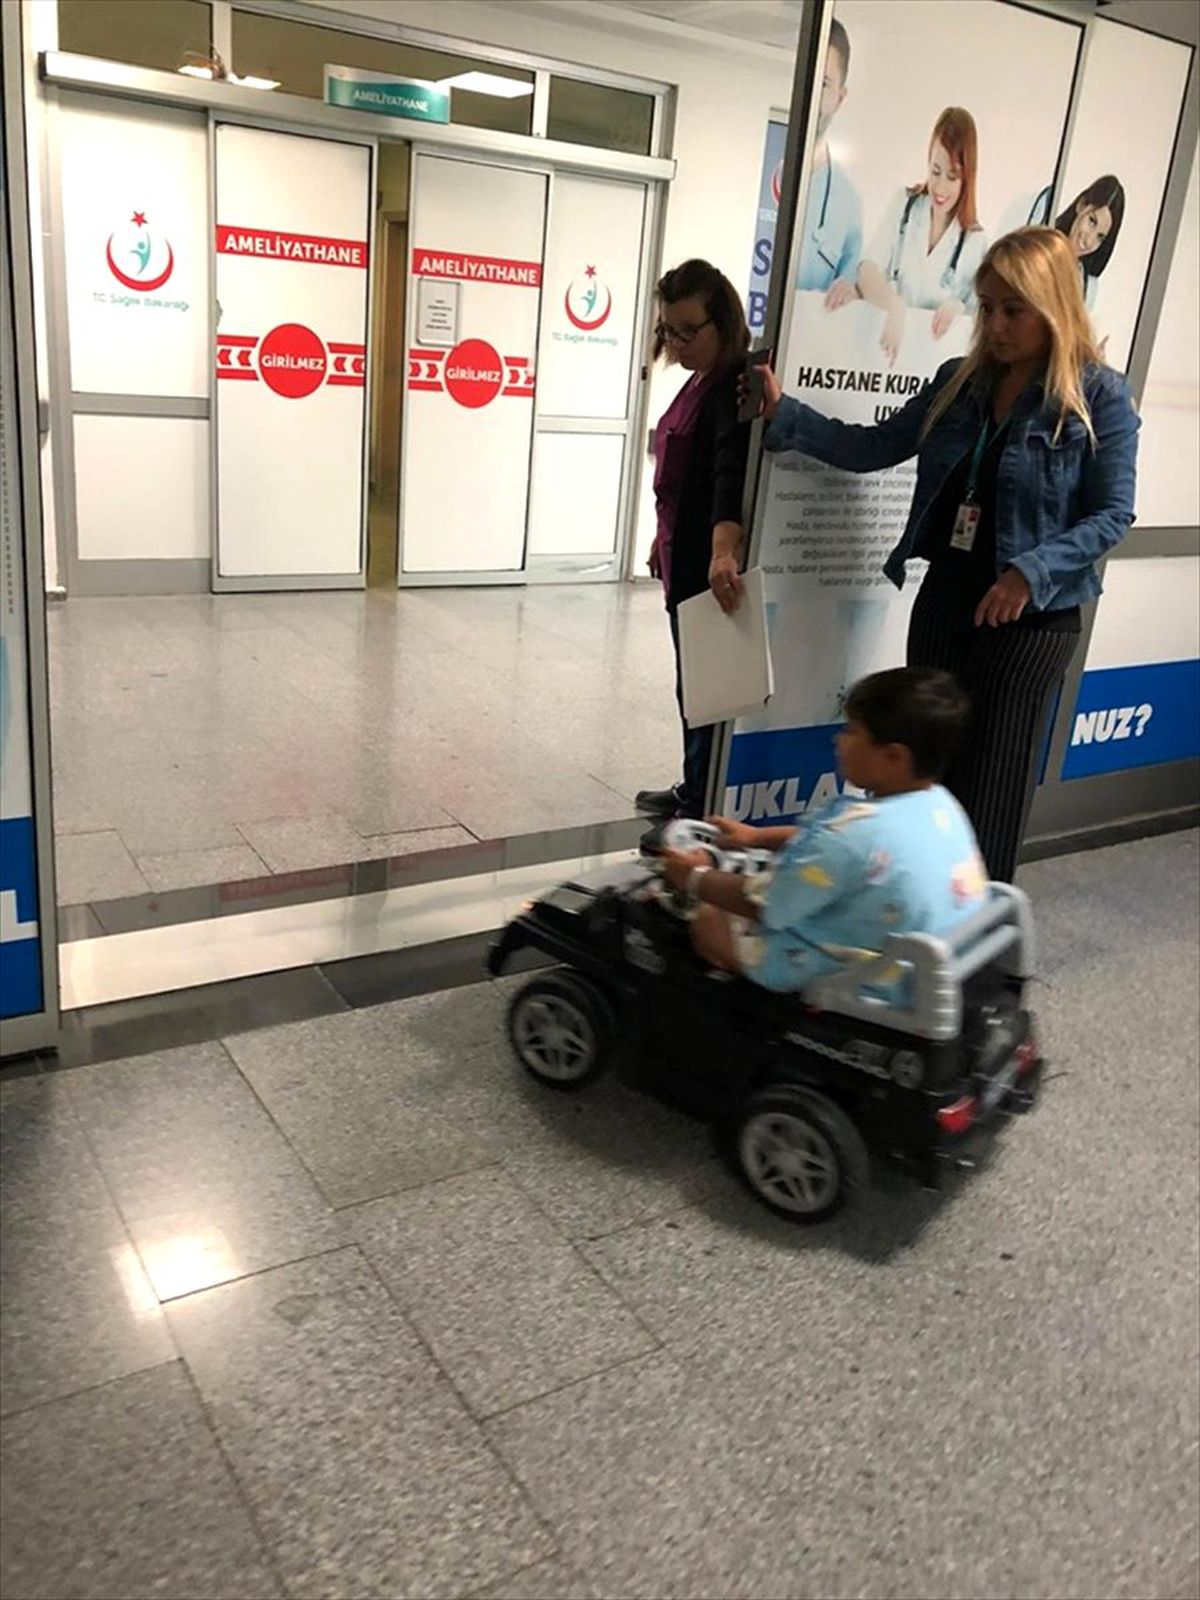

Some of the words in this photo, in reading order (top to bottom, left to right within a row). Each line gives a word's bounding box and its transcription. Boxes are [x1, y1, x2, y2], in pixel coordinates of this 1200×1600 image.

[225, 234, 361, 264] AMELİYATHANE
[420, 257, 537, 284] AMELİYATHANE
[261, 353, 324, 372] GİRİLMEZ
[446, 365, 501, 383] GİRİLMEZ
[798, 366, 881, 393] HASTANE
[1071, 703, 1153, 746] NUZ?
